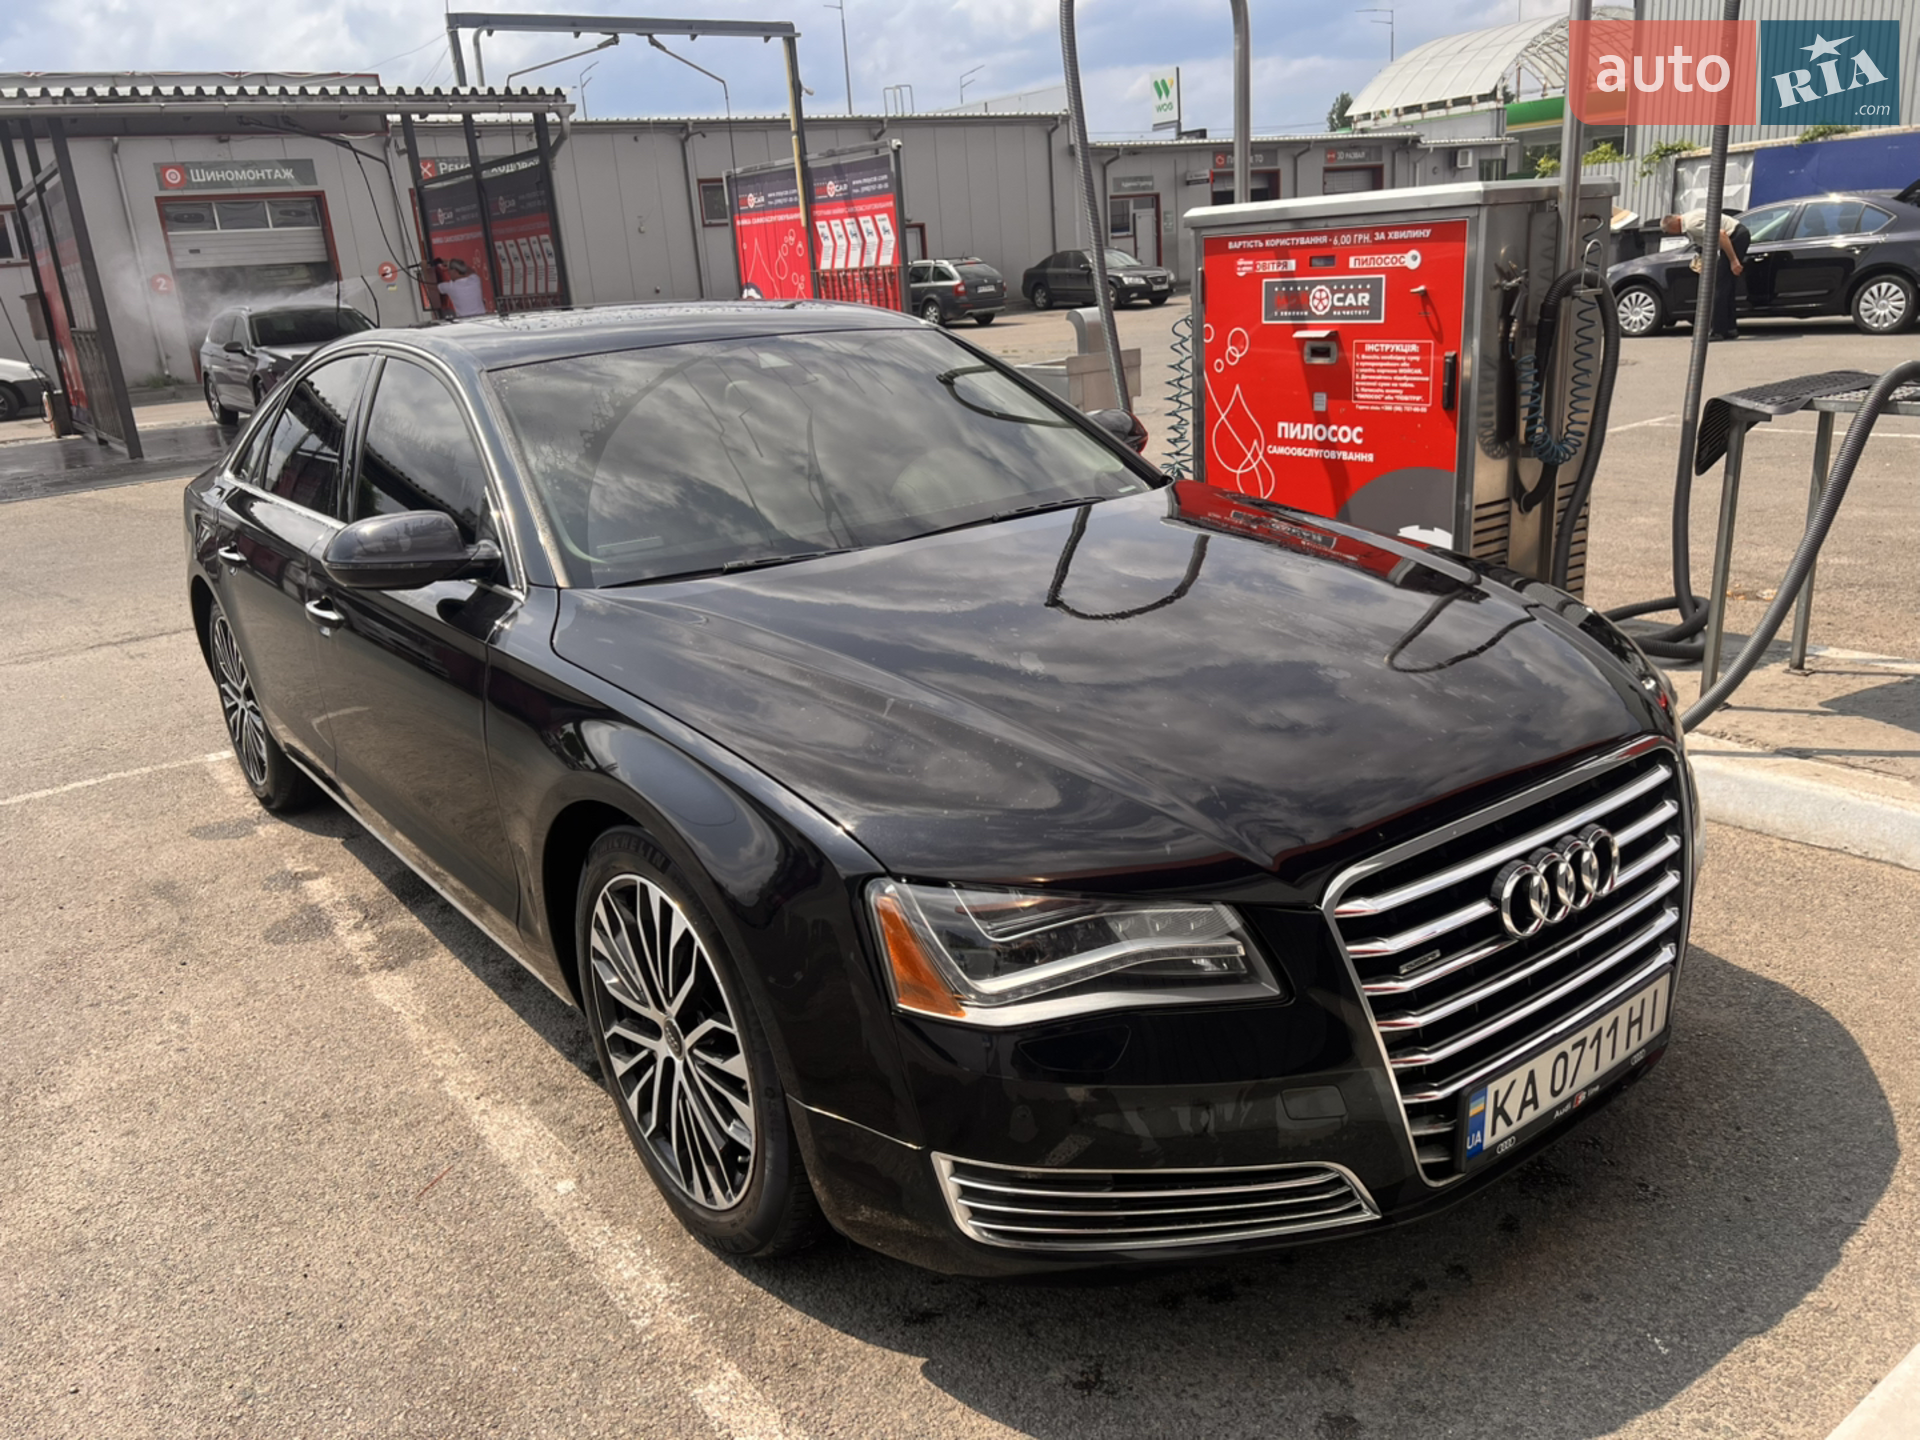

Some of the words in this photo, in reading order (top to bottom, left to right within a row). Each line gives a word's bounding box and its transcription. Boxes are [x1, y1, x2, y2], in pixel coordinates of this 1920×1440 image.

[1155, 101, 1174, 113] WOG
[1228, 239, 1264, 250] ВАРТІСТЬ
[1265, 235, 1328, 248] КОРИСТУВАННЯ
[1333, 235, 1352, 246] 6,00
[1353, 233, 1373, 244] ГРН.
[1374, 231, 1386, 241] ЗА
[1387, 229, 1432, 240] ХВИЛИНУ
[1354, 255, 1406, 267] ПИЛОСОС
[382, 266, 392, 279] 3
[156, 278, 168, 291] 2
[1333, 292, 1371, 307] CAR
[1364, 343, 1420, 354] ІНСТРУКЦІЯ:
[1277, 421, 1364, 444] ПИЛОСОС
[1267, 444, 1374, 462] САМООБСЛУГОВУВАННЯ
[1490, 1067, 1540, 1138] KA
[1549, 1014, 1620, 1099] 0711
[1624, 988, 1660, 1051] HI
[1466, 1130, 1483, 1150] UA
